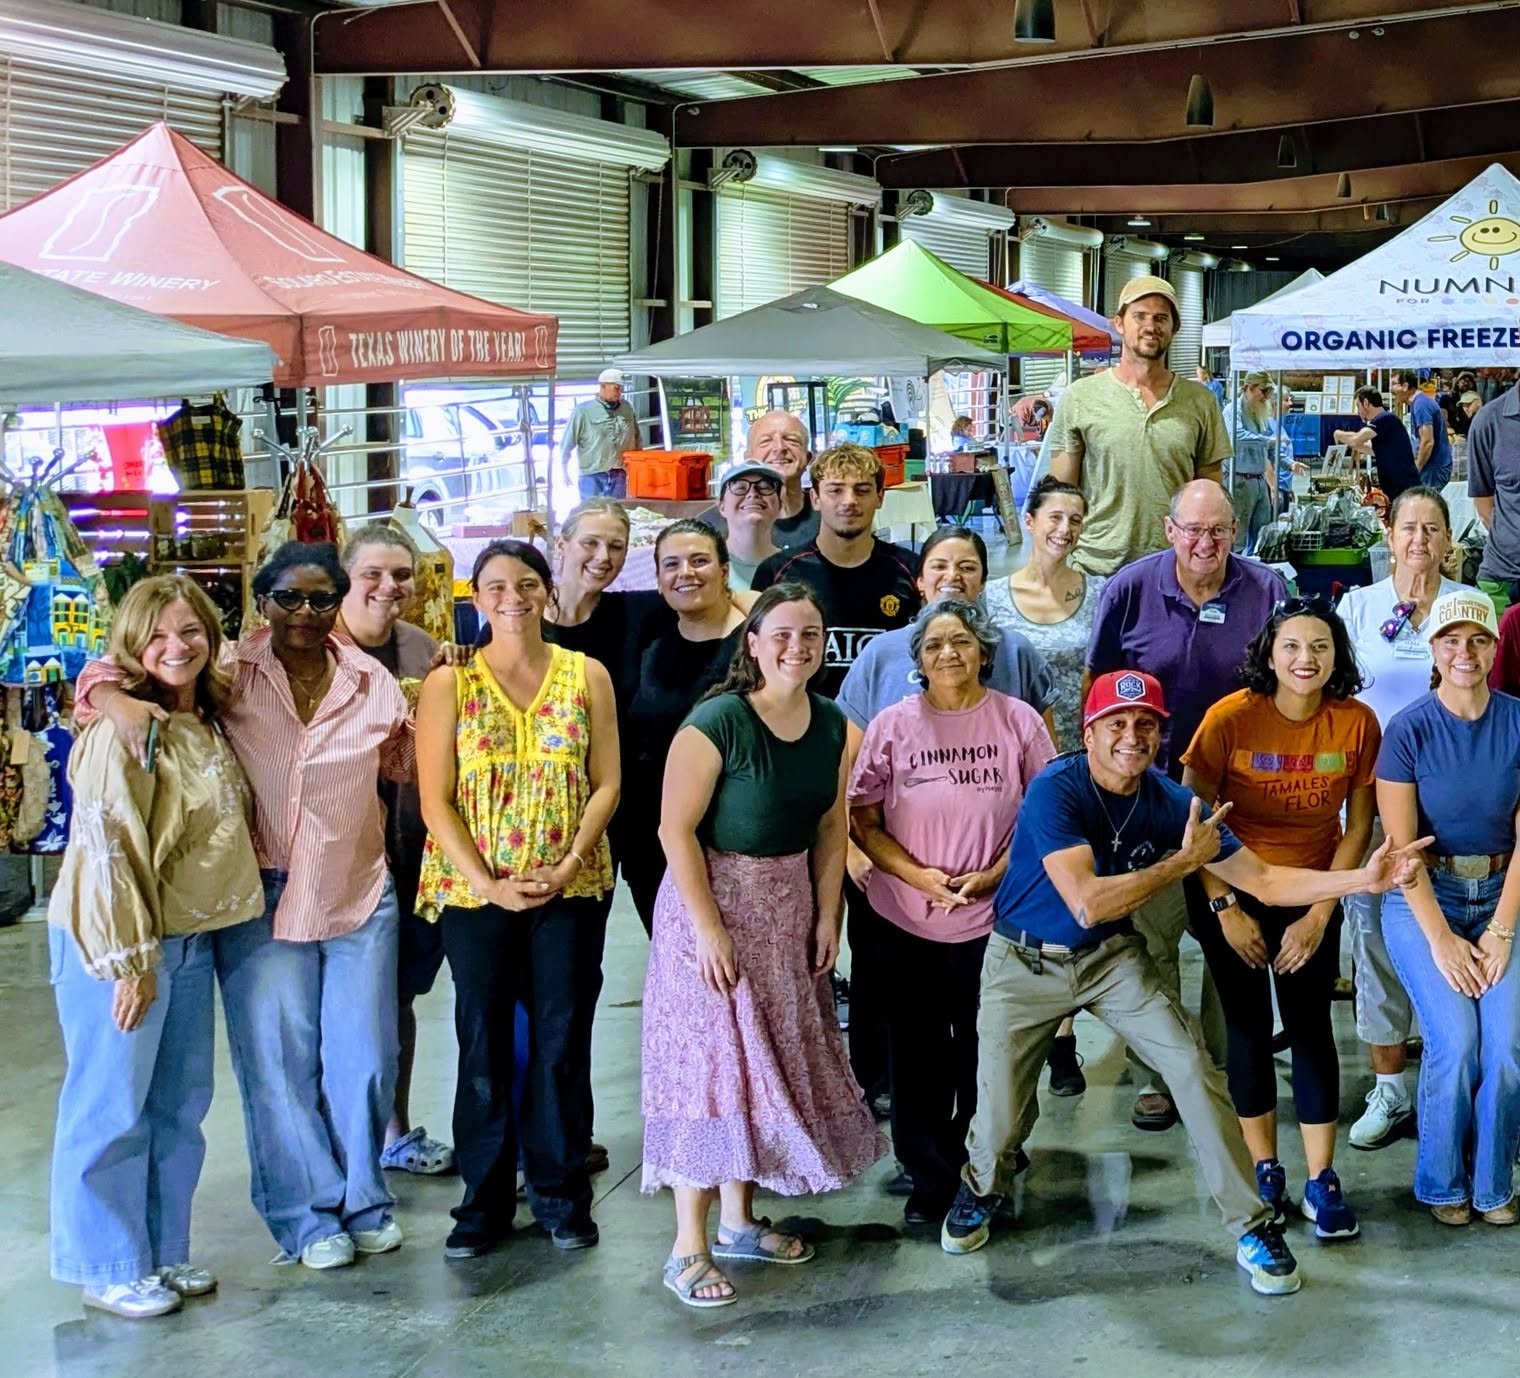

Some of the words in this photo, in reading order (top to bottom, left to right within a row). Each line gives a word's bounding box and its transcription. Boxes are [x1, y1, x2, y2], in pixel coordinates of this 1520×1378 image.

[33, 268, 108, 284] TATE
[109, 271, 221, 290] WINERY
[349, 331, 394, 368] TEXAS
[396, 328, 446, 364] WINERY
[449, 328, 464, 362] OF
[467, 330, 490, 363] THE
[493, 329, 526, 363] YEAR!
[1281, 329, 1418, 351] ORGANIC
[1427, 327, 1520, 349] FREEZE
[1120, 681, 1141, 691] ROCK
[909, 744, 998, 770] CINNAMON
[948, 767, 1004, 785] SUGAR
[1256, 776, 1330, 800] TAMALES
[1284, 789, 1331, 812] FLOR
